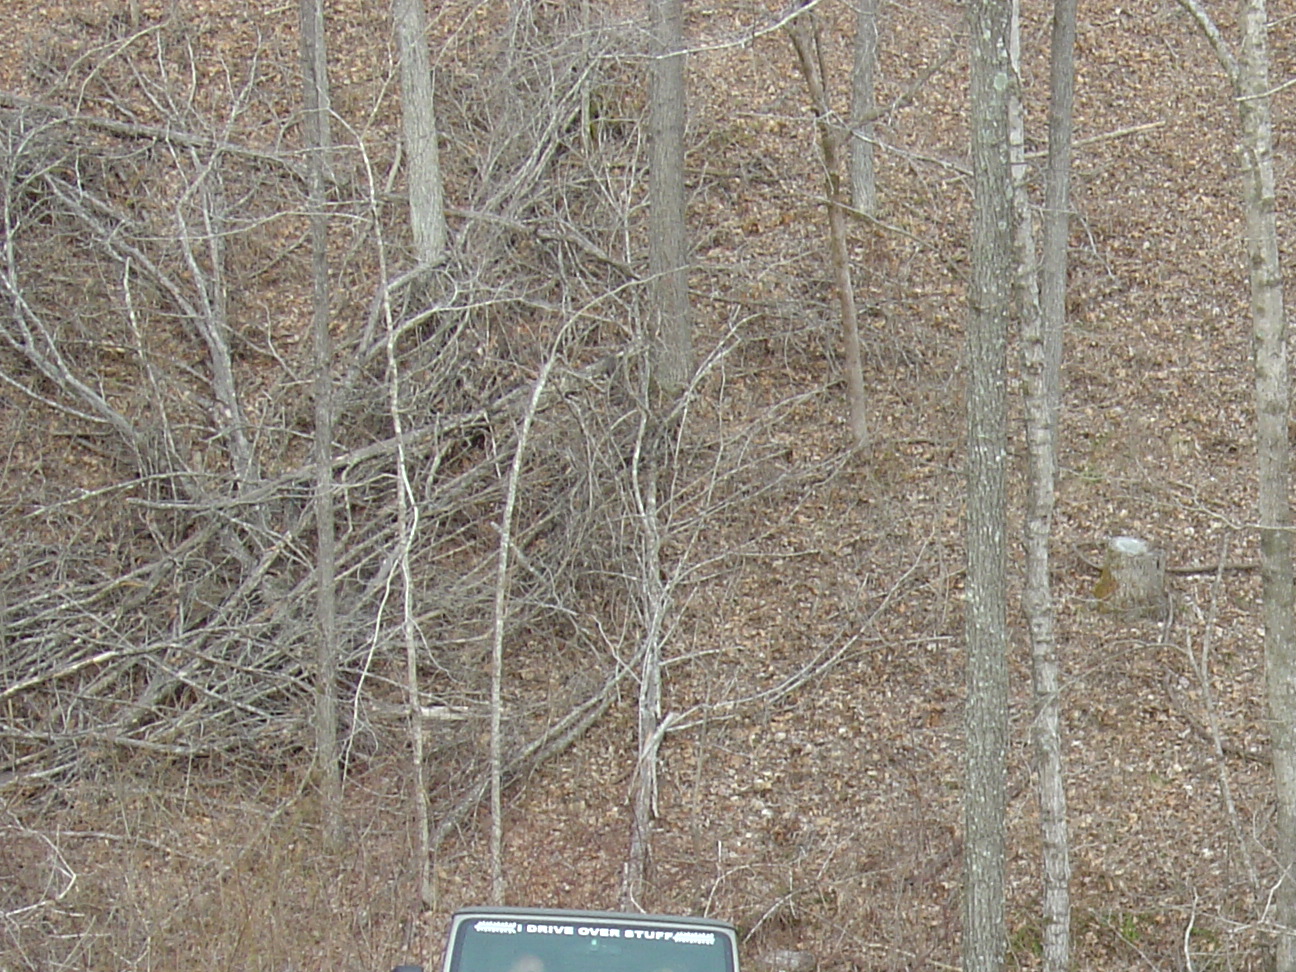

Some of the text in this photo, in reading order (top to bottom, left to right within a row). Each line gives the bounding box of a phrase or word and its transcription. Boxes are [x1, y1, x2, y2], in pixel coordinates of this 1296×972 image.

[517, 924, 673, 940] I DRIVE OVER STUFF
